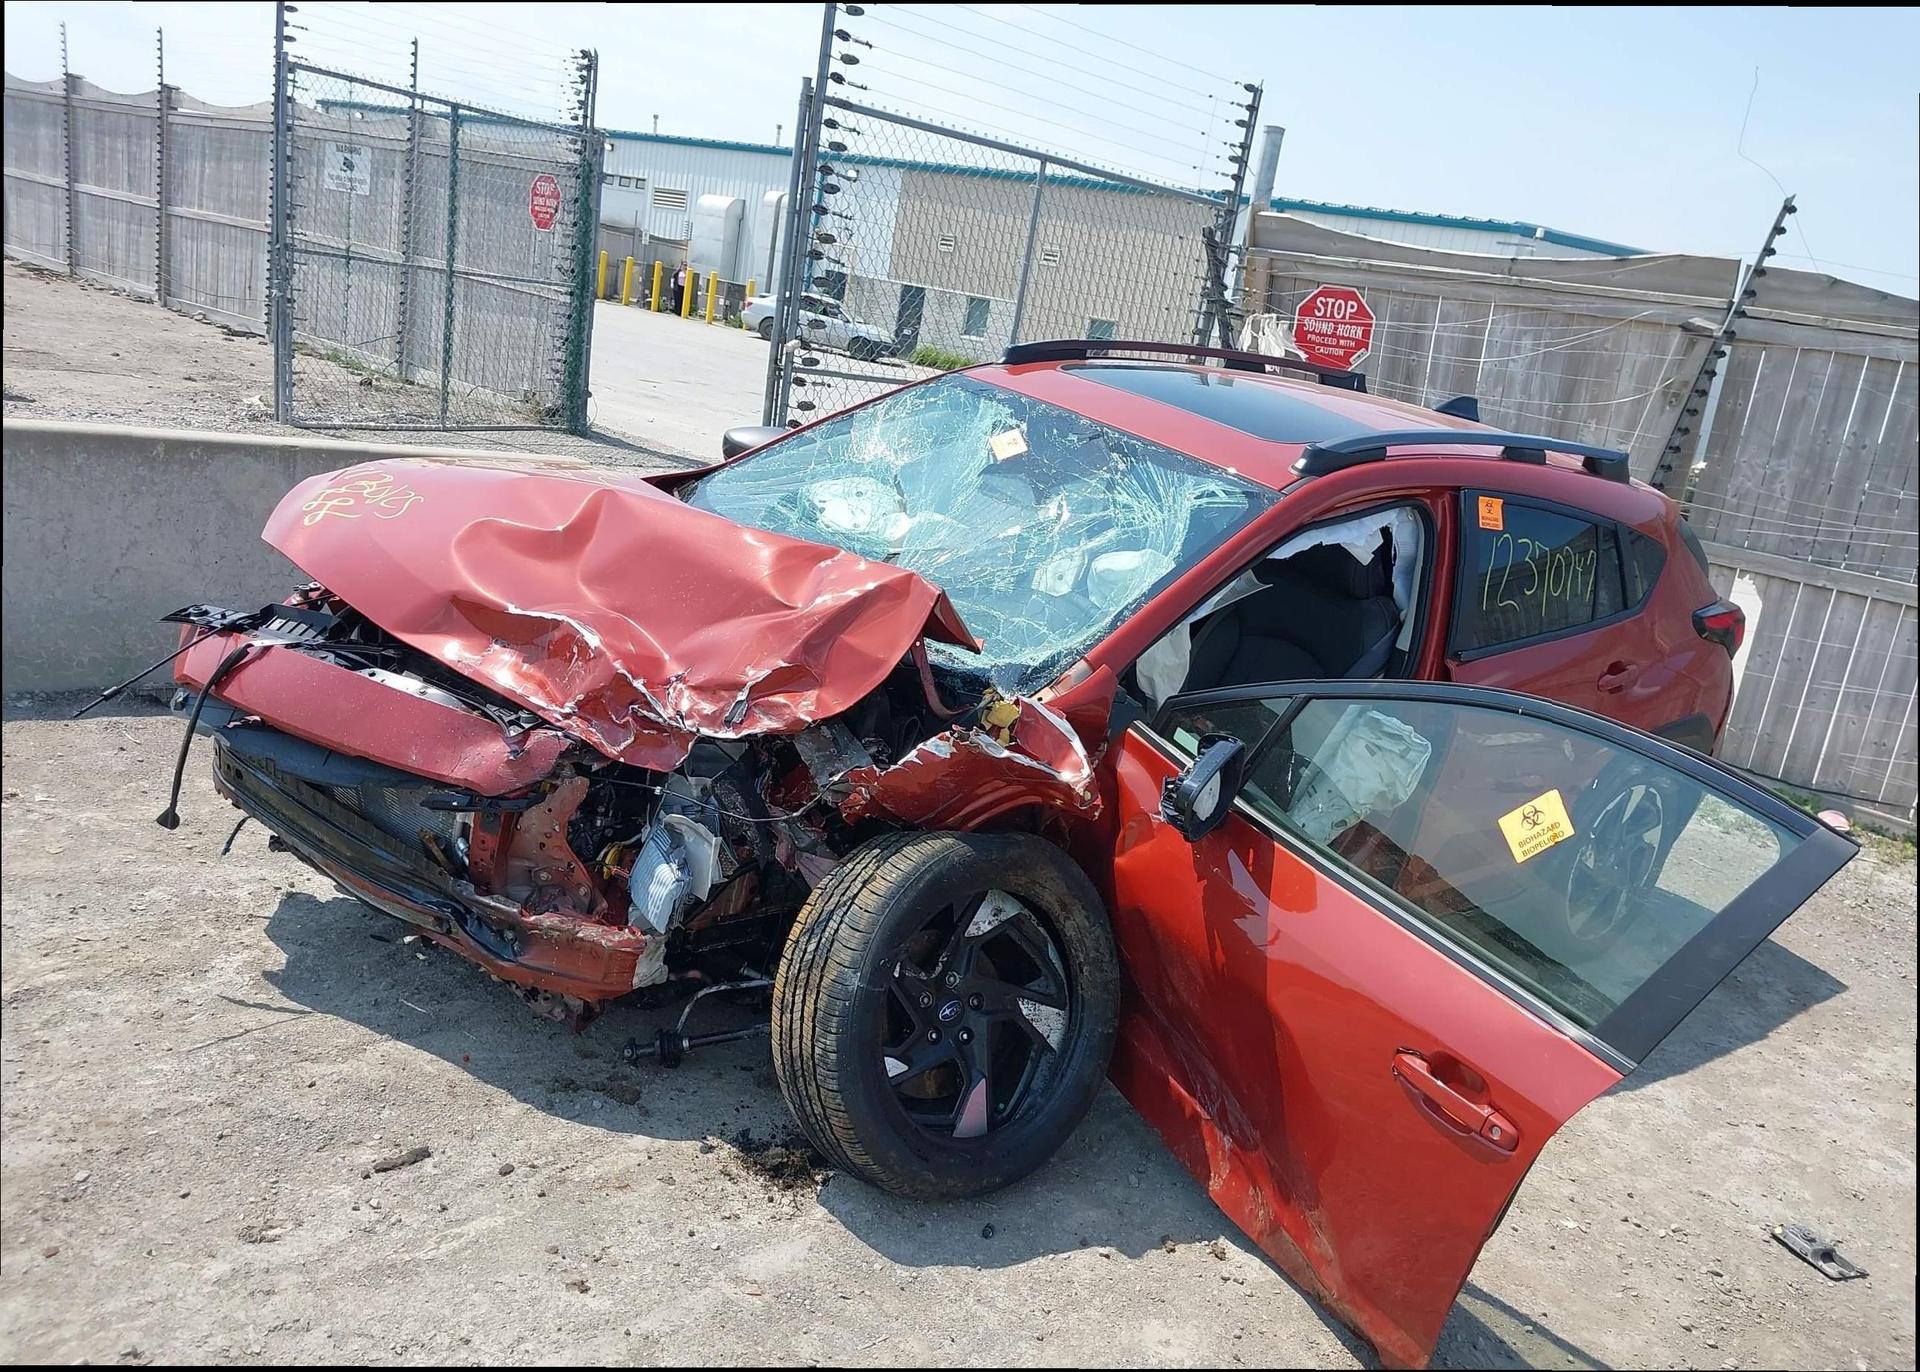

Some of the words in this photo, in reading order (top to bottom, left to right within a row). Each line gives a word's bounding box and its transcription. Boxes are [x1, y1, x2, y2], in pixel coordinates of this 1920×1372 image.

[1314, 297, 1358, 320] STOP
[1303, 319, 1334, 335] SOUND
[1337, 324, 1364, 339] HORN
[1307, 333, 1338, 345] PROCEED
[1339, 340, 1356, 348] WITH
[1315, 346, 1345, 356] CAUTION
[1518, 821, 1561, 848] BIOHAZARD
